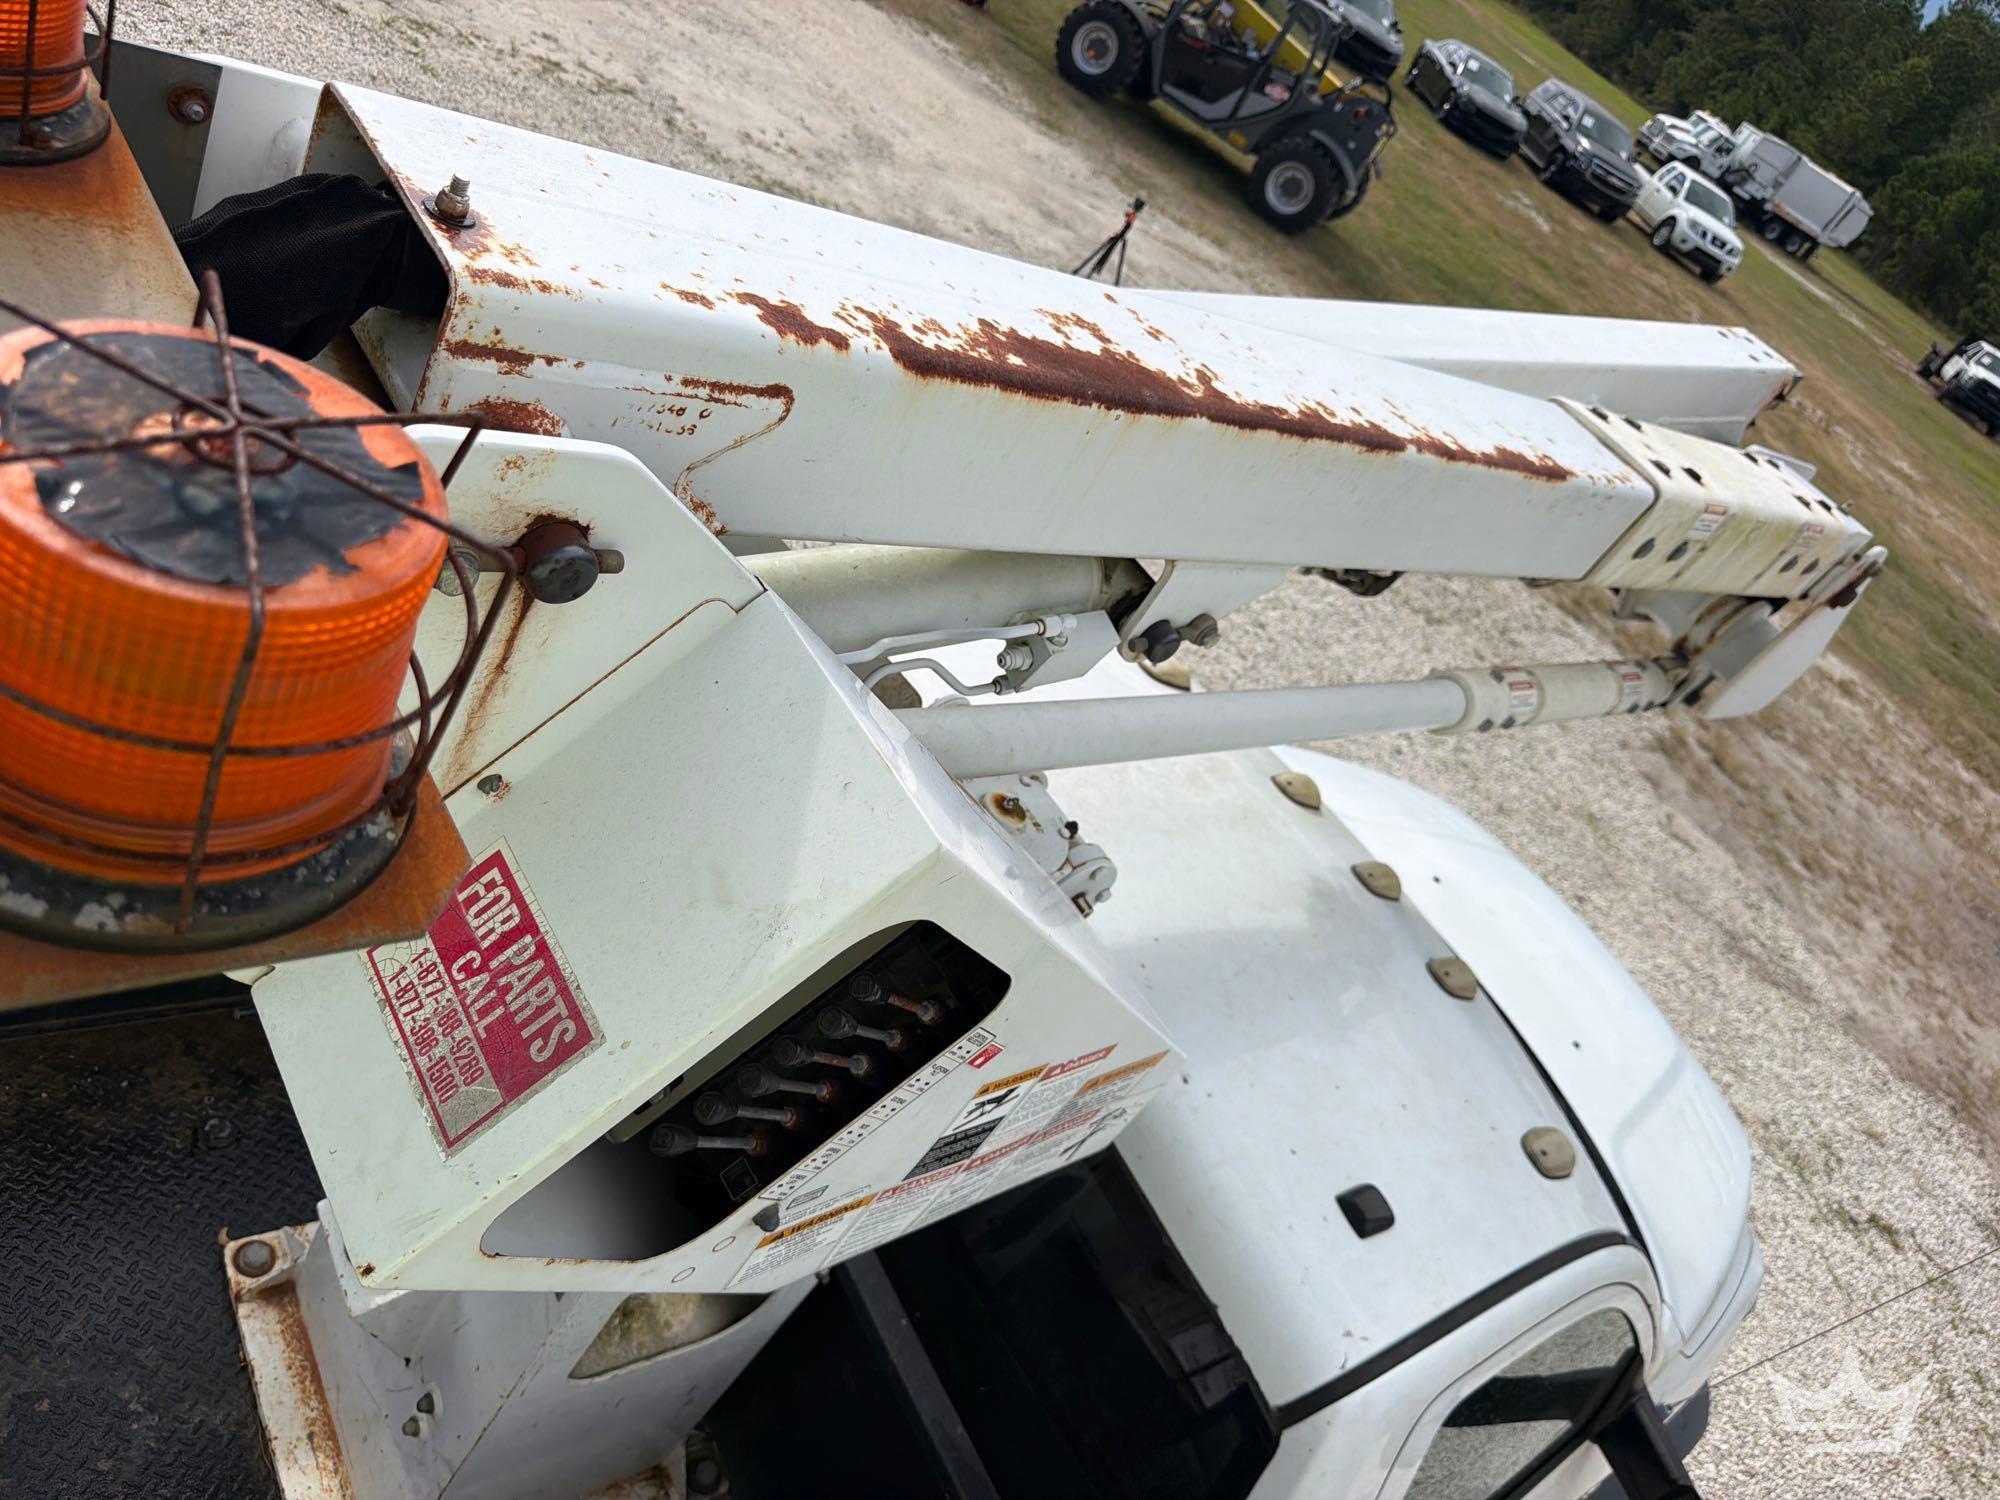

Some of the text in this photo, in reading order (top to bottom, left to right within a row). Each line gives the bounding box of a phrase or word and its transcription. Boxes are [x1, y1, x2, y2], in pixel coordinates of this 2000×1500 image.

[451, 950, 501, 1039] CALL
[457, 867, 577, 1063] FOR PARTS
[388, 966, 461, 1105] 1-877-396-1500
